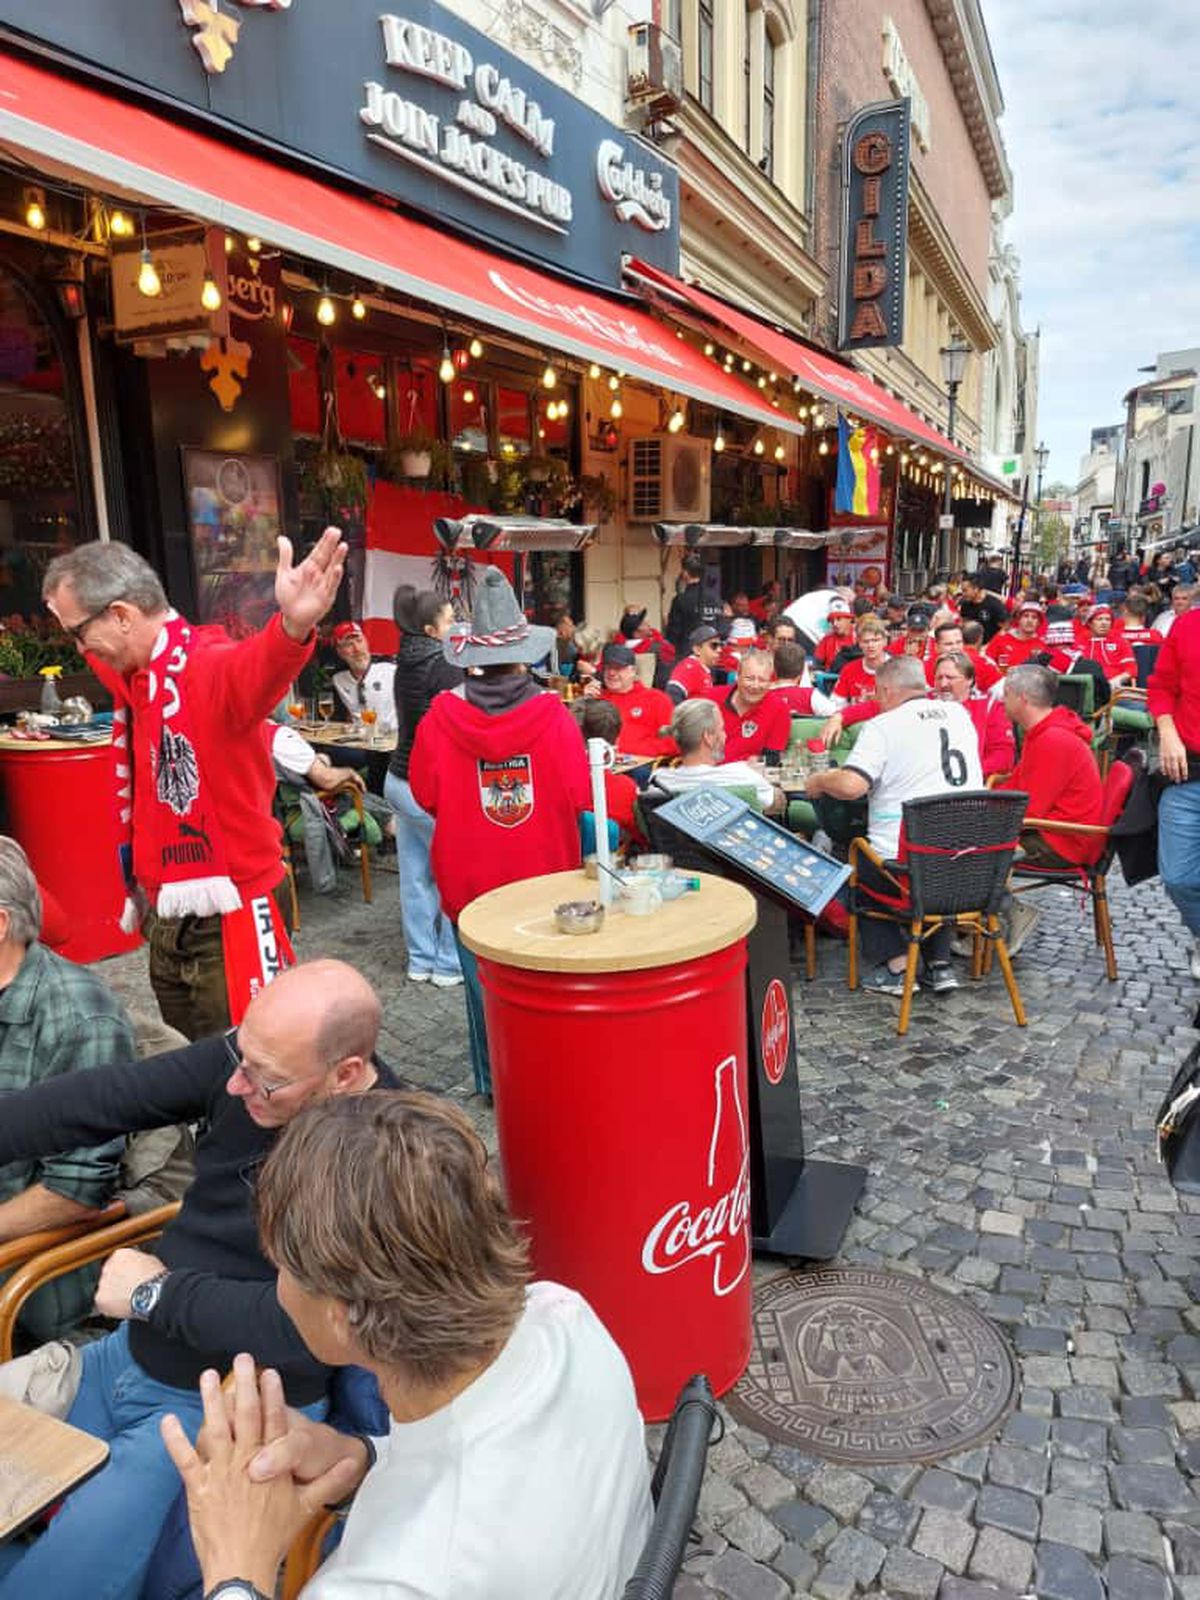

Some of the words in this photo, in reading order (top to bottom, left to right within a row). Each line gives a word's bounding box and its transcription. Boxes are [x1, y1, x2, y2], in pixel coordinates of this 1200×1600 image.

[360, 81, 439, 156] JOIN
[525, 170, 573, 221] PUB
[379, 14, 474, 90] KEEP
[474, 63, 555, 158] CALM
[456, 99, 497, 137] AND
[850, 129, 893, 339] GILDA
[939, 727, 968, 787] 6
[642, 1150, 750, 1274] Coca-C
